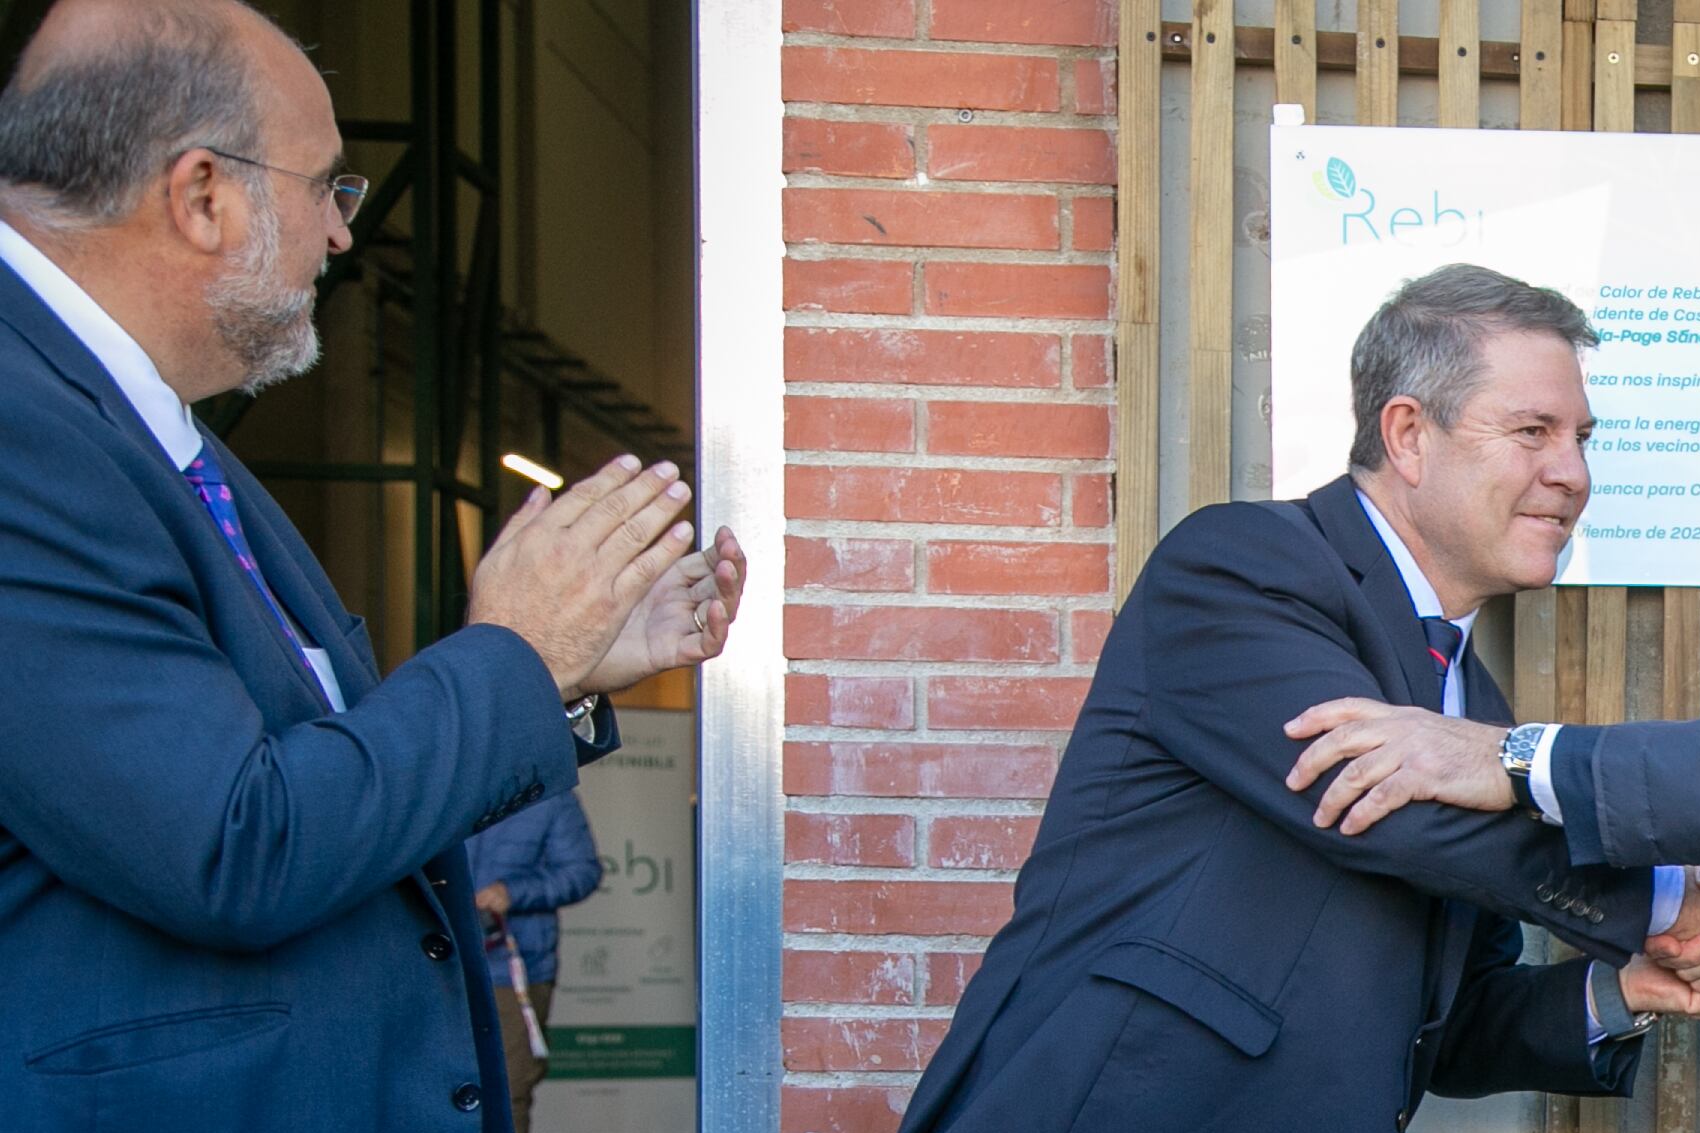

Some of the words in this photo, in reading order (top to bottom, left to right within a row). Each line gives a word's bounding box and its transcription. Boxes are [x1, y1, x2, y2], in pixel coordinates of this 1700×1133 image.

[1600, 285, 1644, 299] Calor
[1648, 286, 1668, 299] de
[1591, 306, 1645, 321] idente
[1649, 307, 1669, 321] de
[1598, 328, 1662, 346] ía-Page
[1584, 372, 1618, 387] leza
[1622, 375, 1652, 388] nos
[1592, 417, 1630, 430] nera
[1634, 416, 1650, 430] la
[1602, 440, 1614, 452] a
[1616, 438, 1641, 452] los
[1591, 483, 1644, 496] uenca
[1646, 484, 1686, 499] para
[1576, 525, 1642, 539] viembre
[1645, 525, 1667, 540] de
[598, 838, 674, 897] ebi
